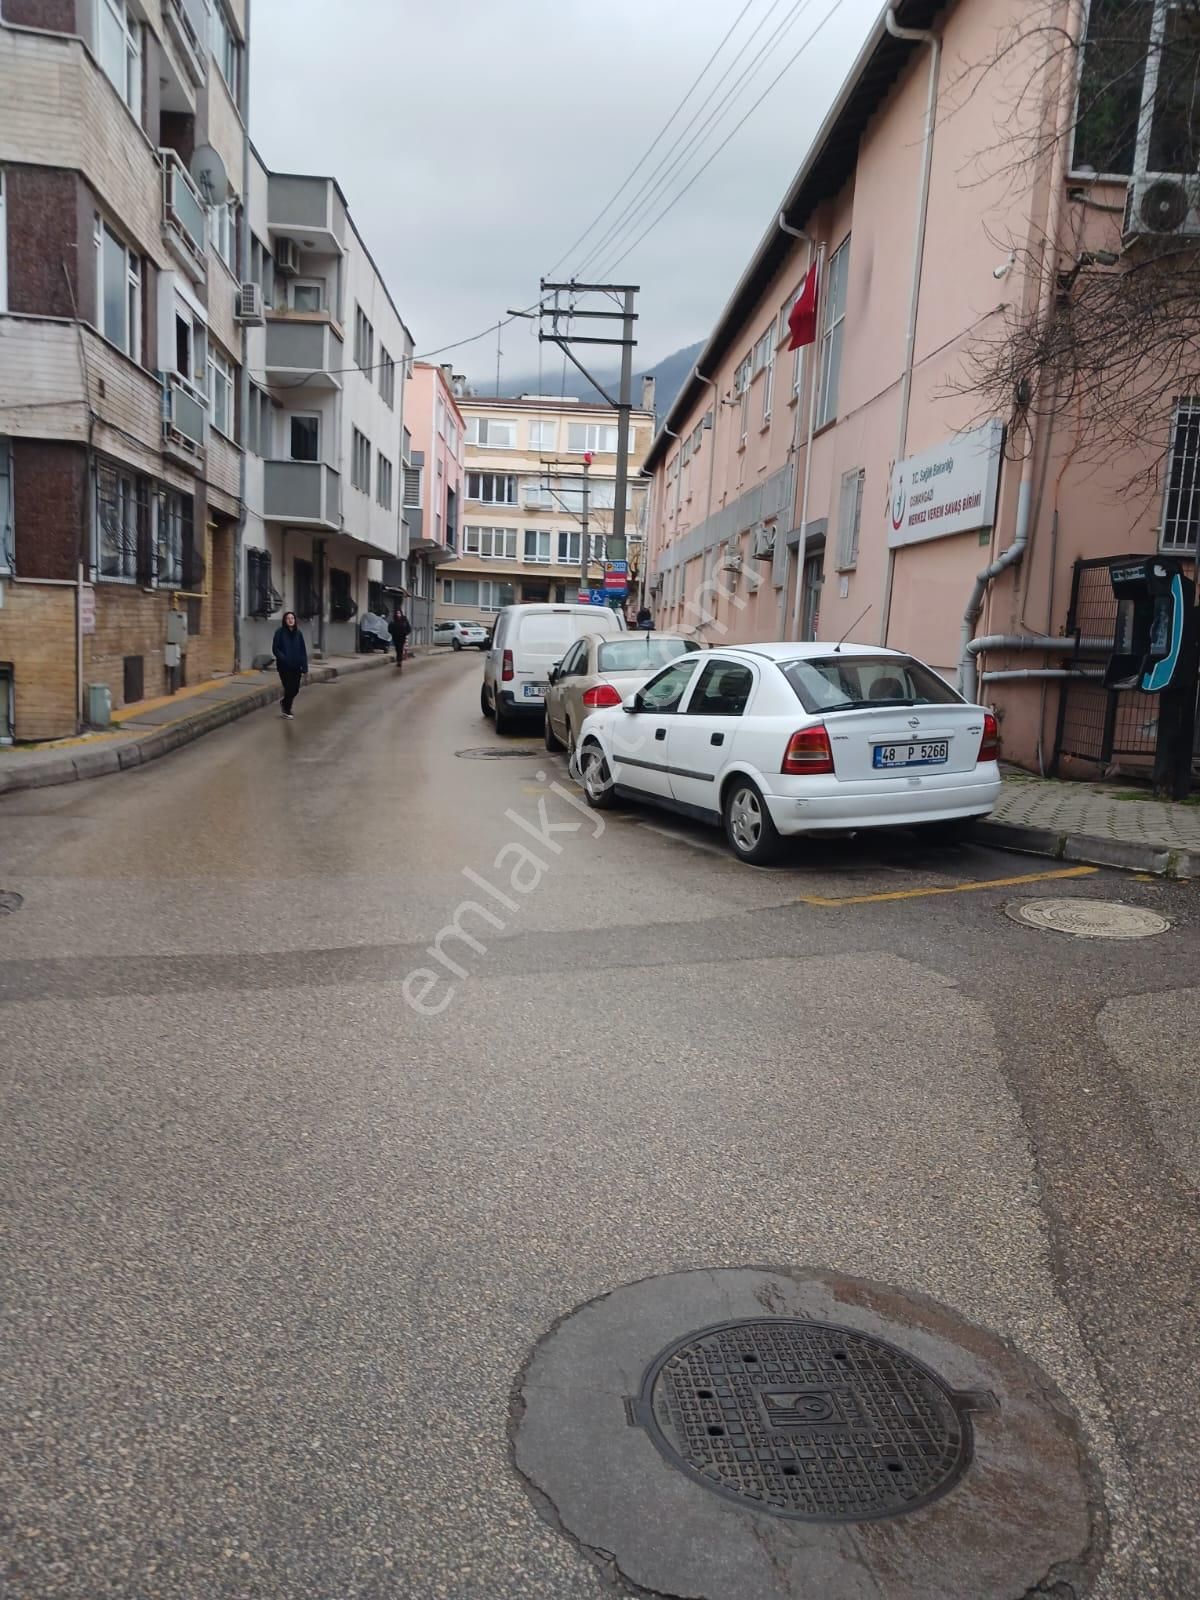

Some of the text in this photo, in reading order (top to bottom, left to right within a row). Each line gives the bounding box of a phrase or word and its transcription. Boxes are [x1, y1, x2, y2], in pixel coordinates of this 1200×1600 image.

[908, 489, 982, 527] MERKEZ VEREM SAVAŞ BİRİMİ
[882, 744, 946, 761] 48 P 5266
